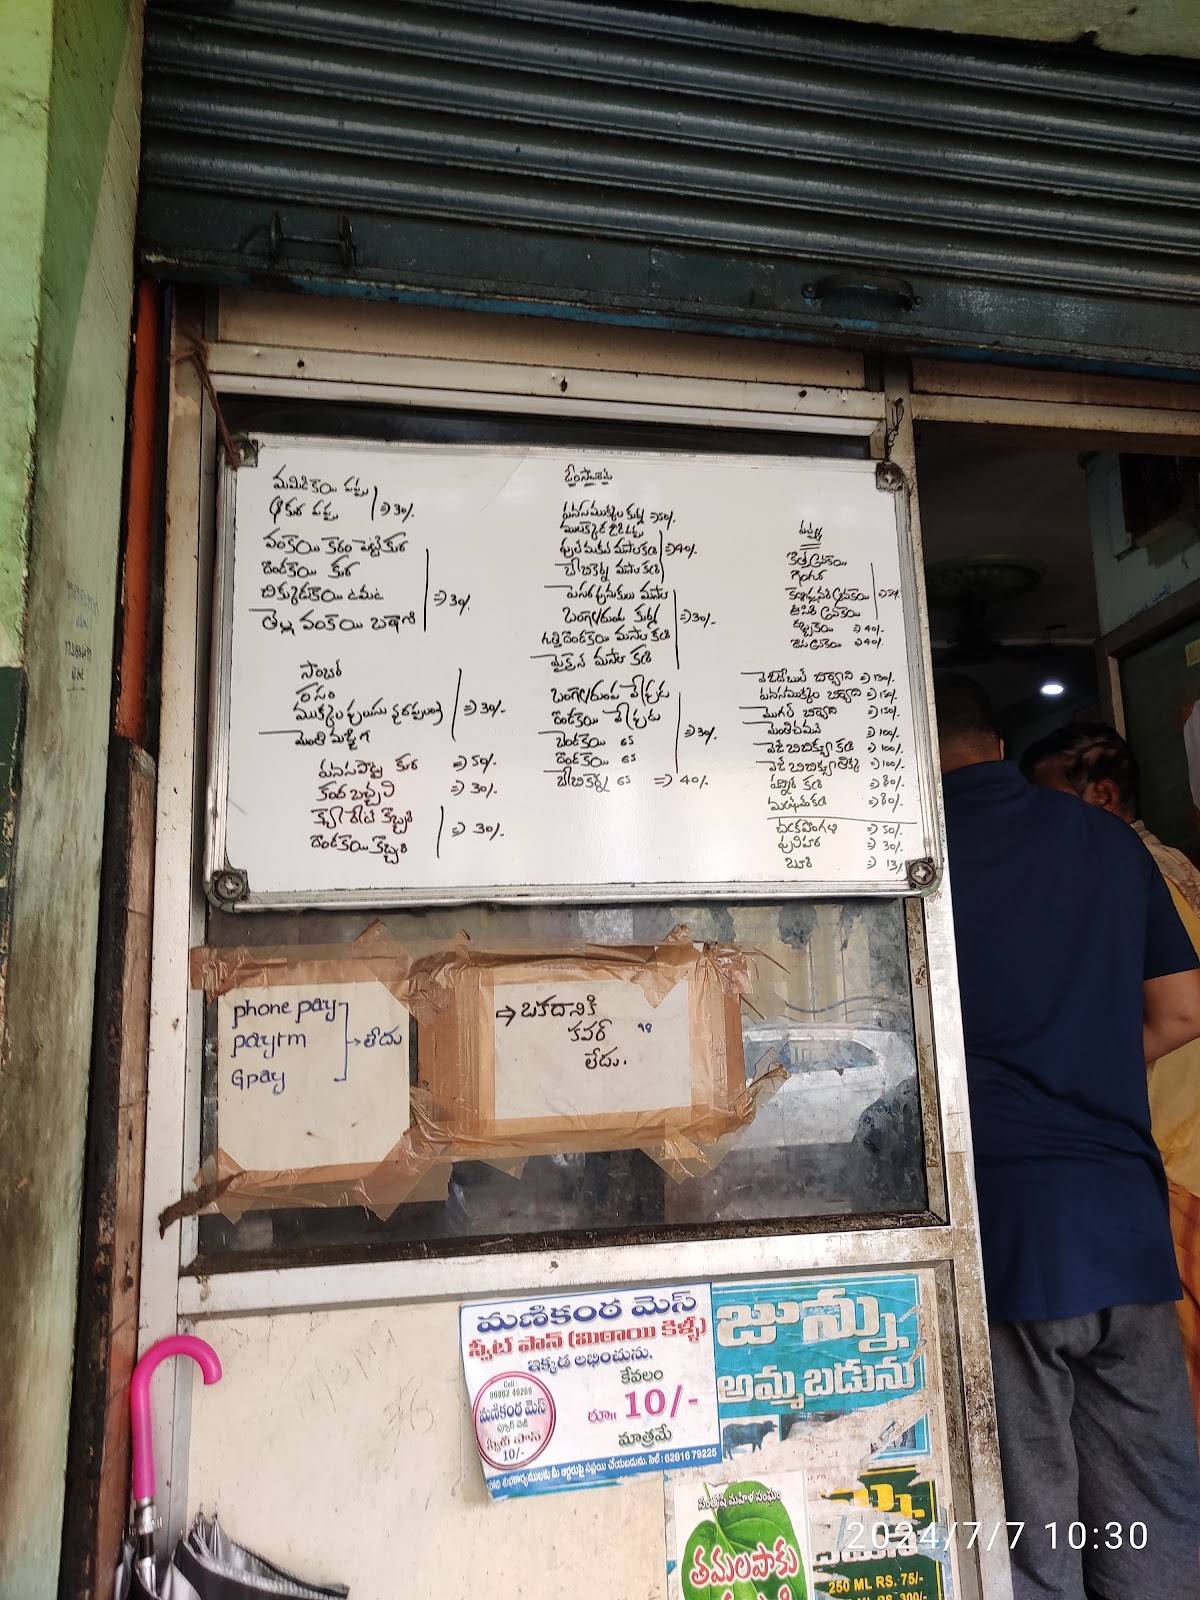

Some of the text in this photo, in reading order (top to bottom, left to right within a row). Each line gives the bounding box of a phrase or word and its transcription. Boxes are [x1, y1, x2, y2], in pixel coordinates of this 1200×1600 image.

[296, 682, 335, 704] రసం
[232, 998, 336, 1029] phone pay
[521, 994, 598, 1018] ఒకదానికి
[568, 1018, 612, 1042] కవర్
[230, 1032, 306, 1059] paytm
[629, 1289, 700, 1318] మెస్
[517, 1331, 563, 1352] పాన్
[619, 1366, 664, 1385] కేవలం
[803, 1355, 917, 1397] బడును
[625, 1384, 700, 1420] 10/-
[618, 1424, 674, 1450] మాత్రమే
[503, 1447, 526, 1462] 10/-
[690, 1538, 799, 1586] తమలపాకు
[828, 1572, 924, 1595] 250 ML RS. 75/-
